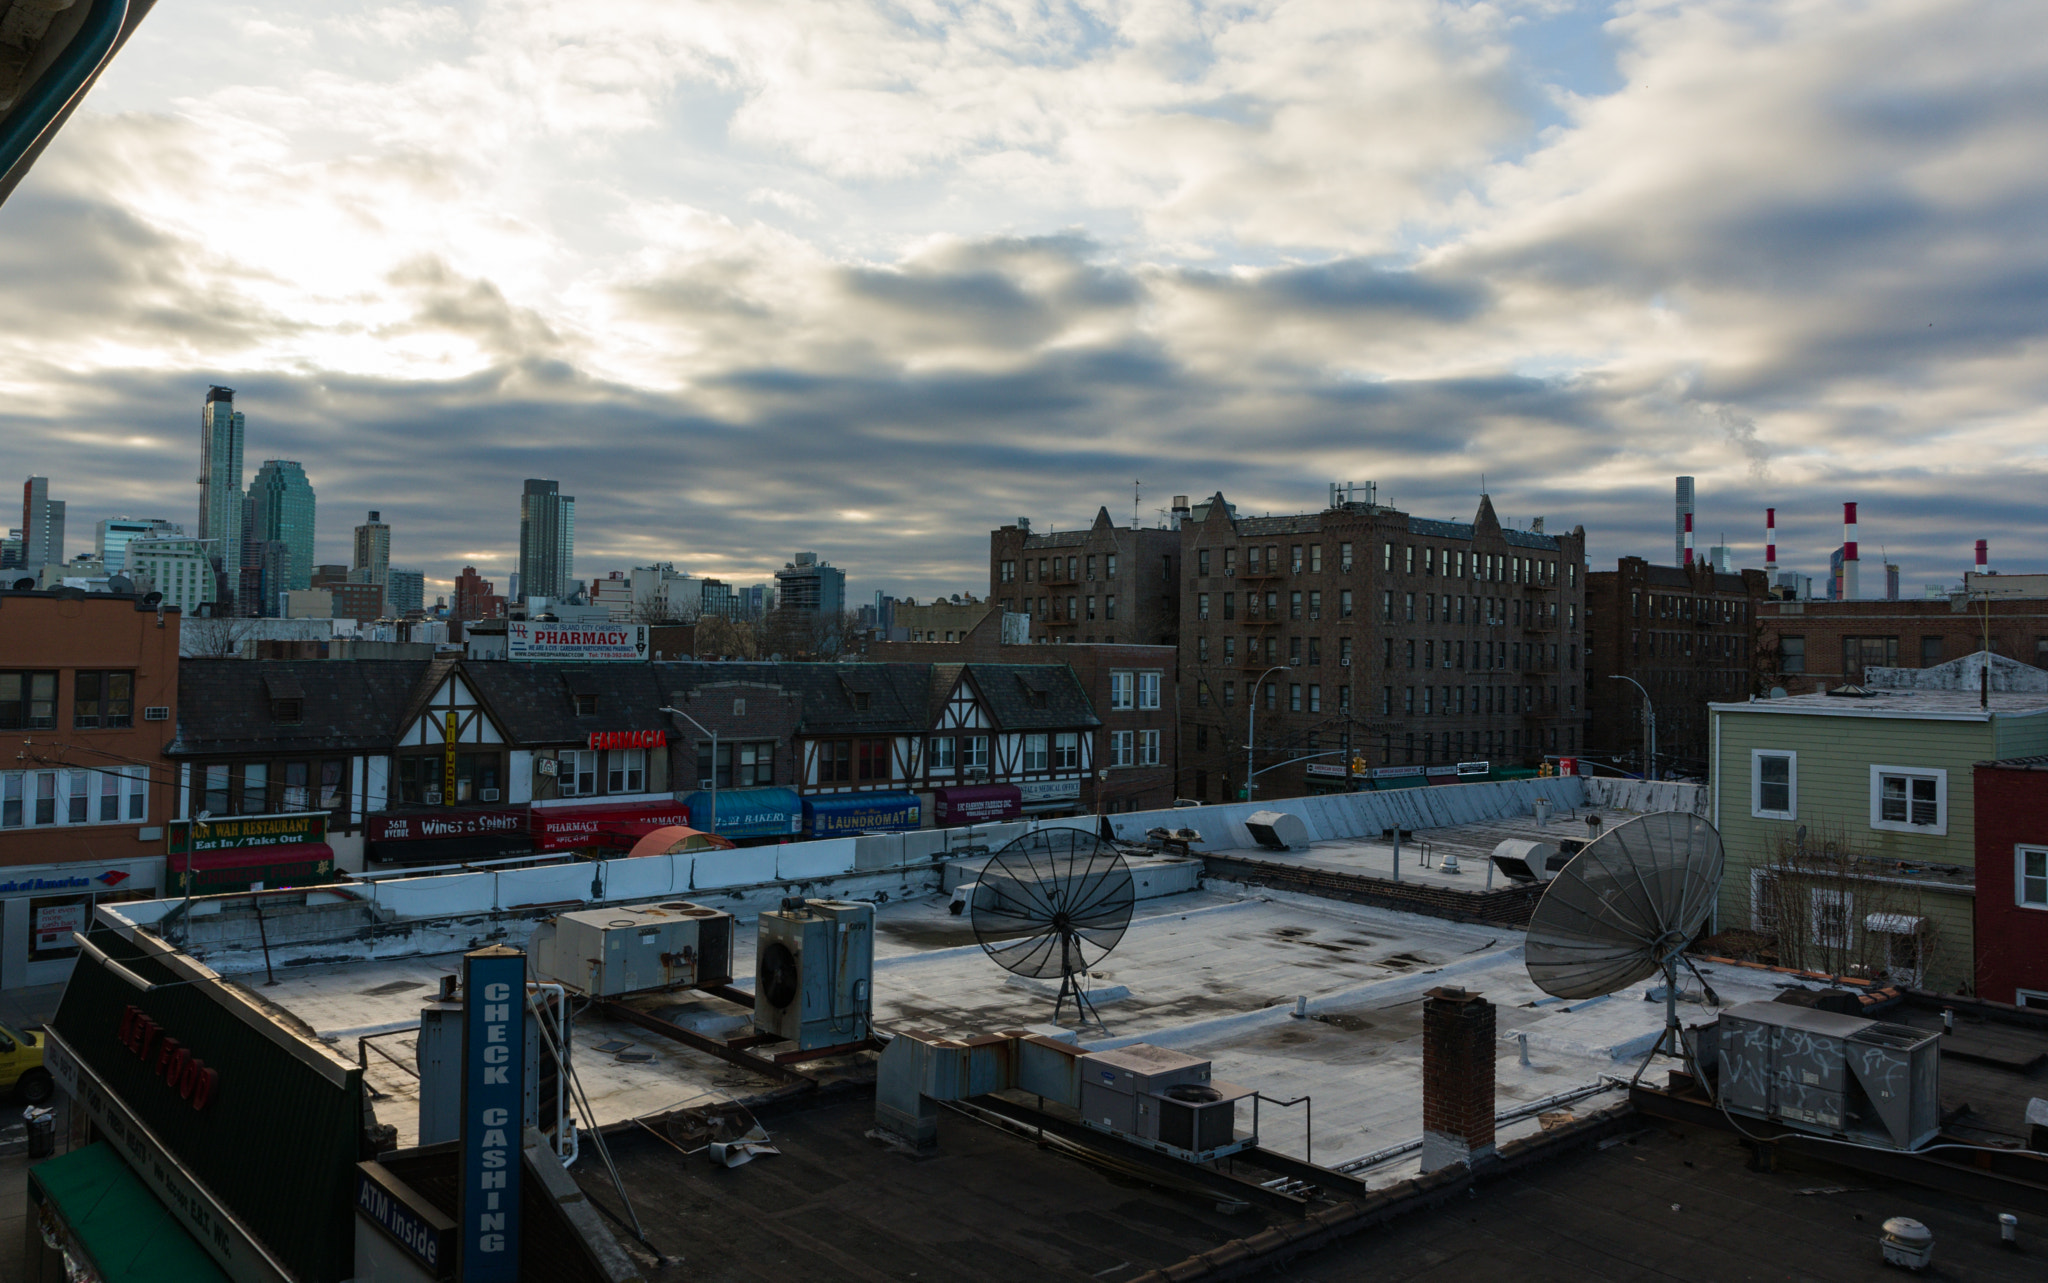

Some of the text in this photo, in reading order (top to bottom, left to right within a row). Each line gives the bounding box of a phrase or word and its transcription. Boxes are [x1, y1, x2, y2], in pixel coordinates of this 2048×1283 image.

[542, 623, 558, 631] LONG
[595, 624, 623, 632] CHEMISTS
[534, 631, 628, 645] PHARMACY
[589, 730, 667, 751] FARMACIA
[446, 719, 455, 801] LIQUORS
[1039, 784, 1061, 793] MEDICAL
[1062, 782, 1080, 791] OFFICE
[467, 820, 476, 832] &
[546, 820, 599, 833] PHARMACY
[640, 815, 688, 826] FARMACIA
[744, 812, 785, 825] BAKERY
[828, 810, 906, 830] LAUNDROMAT
[215, 822, 239, 837] WAH
[242, 818, 310, 836] RESTAURANT
[384, 828, 409, 839] AVENUE
[195, 838, 217, 850] Eat
[220, 838, 234, 848] In
[246, 836, 276, 846] Take
[279, 834, 304, 843] Out
[196, 867, 266, 886] CHINESE
[271, 864, 312, 880] FOOD
[0, 876, 90, 892] nk of America
[60, 919, 77, 927] back
[118, 1004, 219, 1112] KEY FOOD
[479, 983, 511, 1253] CHECK CASHING
[360, 1179, 436, 1264] ATM inside
